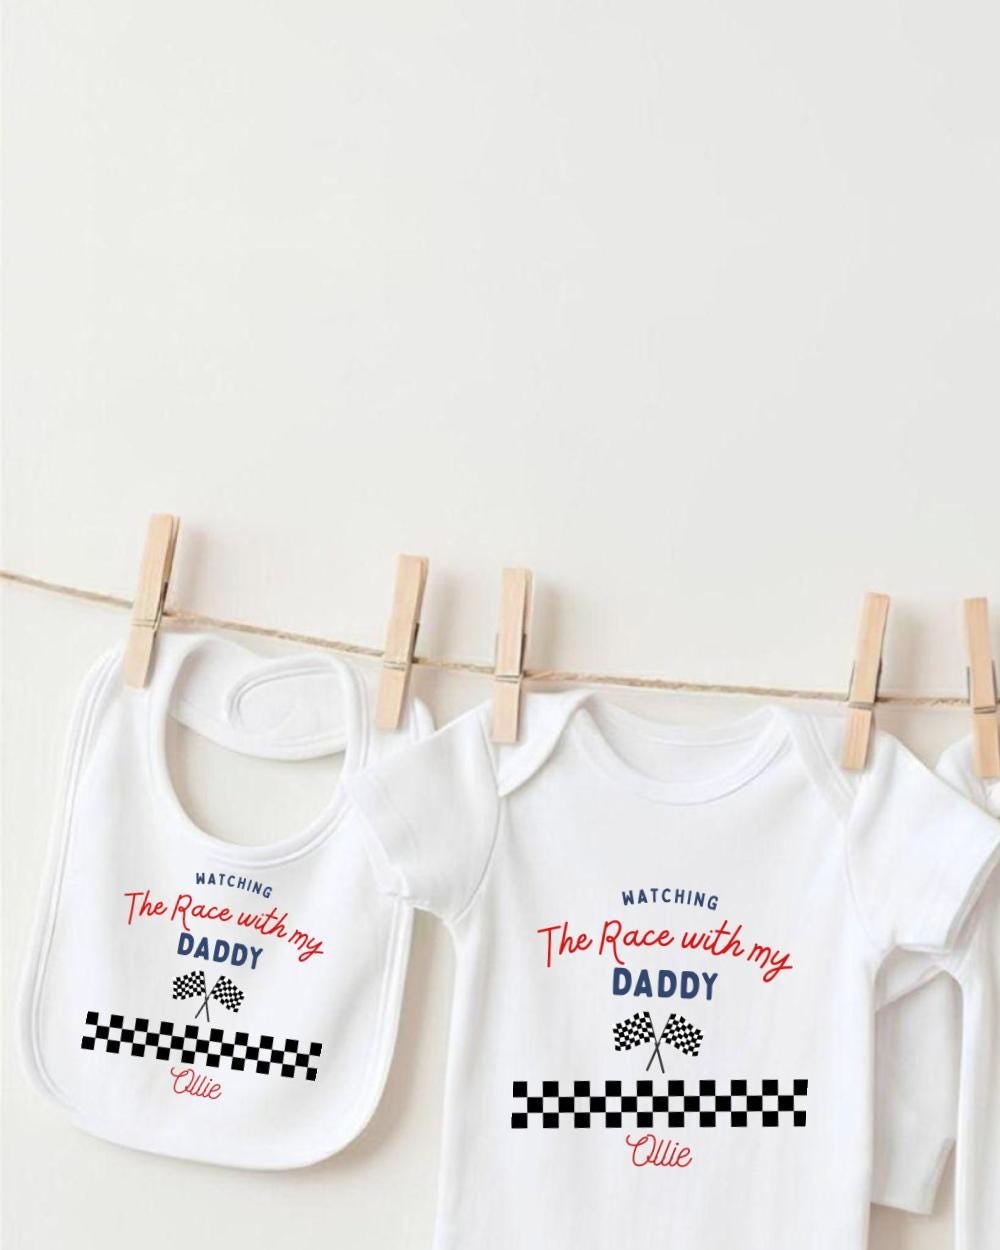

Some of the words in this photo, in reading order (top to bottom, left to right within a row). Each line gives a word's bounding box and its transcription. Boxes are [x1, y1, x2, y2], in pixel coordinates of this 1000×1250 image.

[196, 872, 272, 899] WATCHING
[622, 888, 719, 911] WATCHING
[124, 890, 168, 925] The
[171, 893, 233, 932] Race
[237, 908, 288, 939] with
[288, 928, 324, 963] my
[177, 932, 263, 970] DADDY
[537, 922, 593, 969] The
[598, 919, 675, 966] Race
[681, 919, 745, 958] with
[746, 943, 793, 984] my
[611, 966, 719, 1001] DADDY
[170, 1066, 222, 1100] Ollie
[626, 1135, 693, 1168] Ollie
